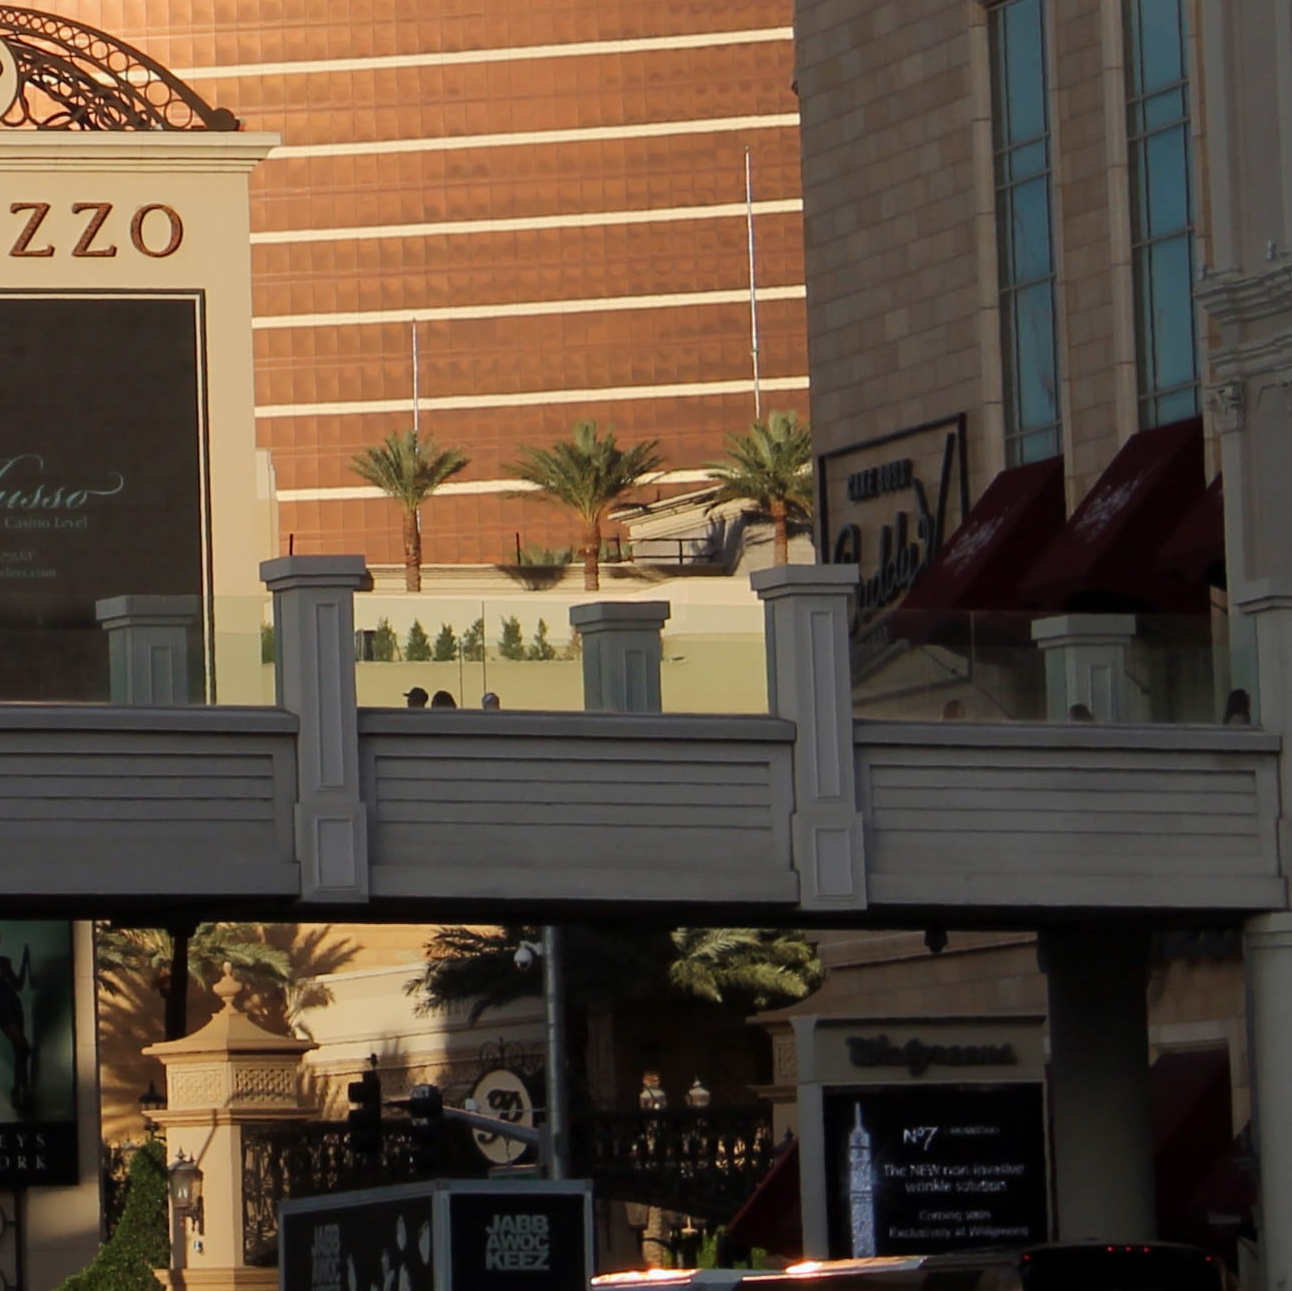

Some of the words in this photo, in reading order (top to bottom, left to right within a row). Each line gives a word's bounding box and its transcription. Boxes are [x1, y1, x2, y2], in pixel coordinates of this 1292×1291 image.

[3, 515, 51, 530] Casino
[54, 515, 89, 530] Level
[485, 1214, 549, 1234] JABB
[485, 1233, 550, 1251] AWOC
[485, 1251, 551, 1271] KEEZ
